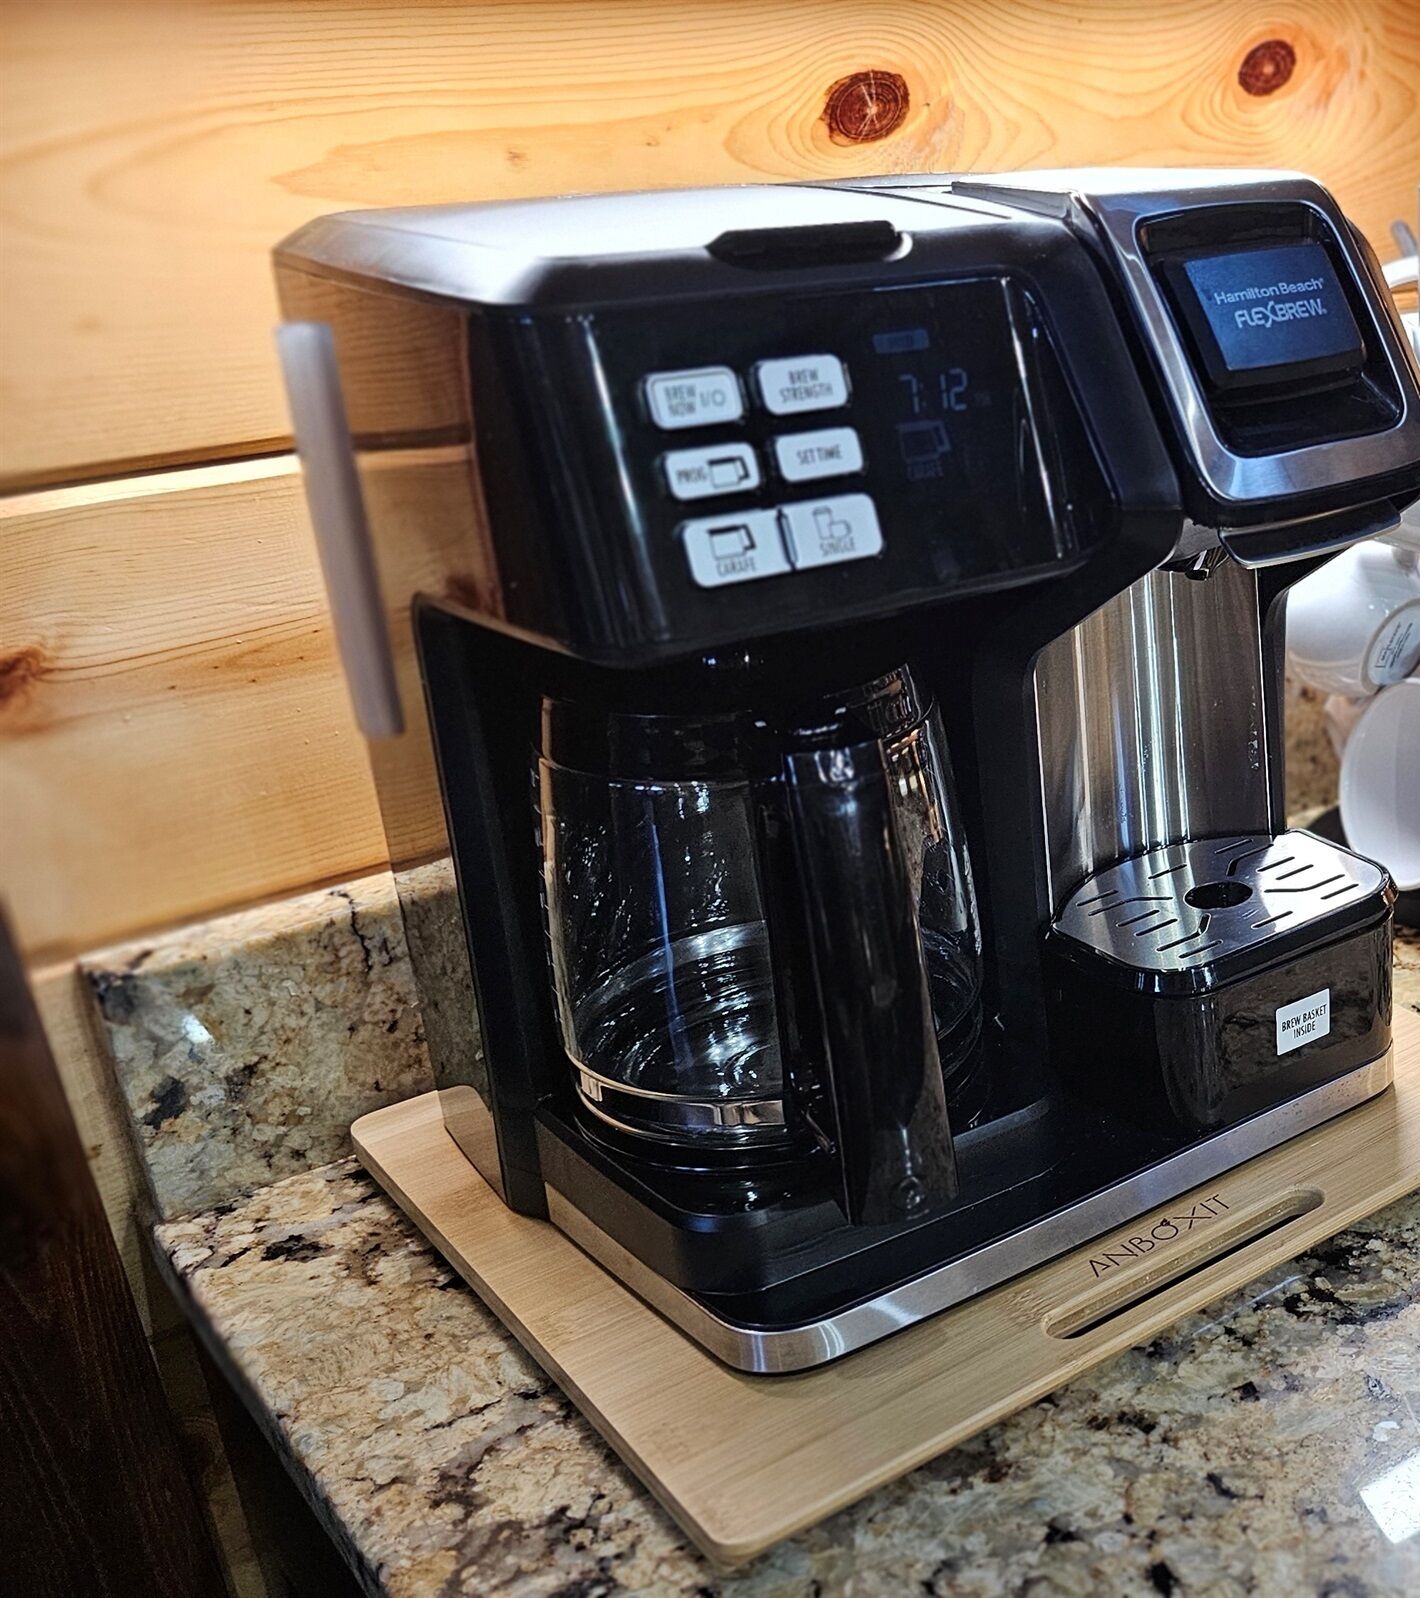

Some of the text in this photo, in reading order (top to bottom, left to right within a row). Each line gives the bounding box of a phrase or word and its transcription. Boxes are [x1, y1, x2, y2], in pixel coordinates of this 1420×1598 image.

[1214, 285, 1280, 304] Hamilton
[787, 367, 819, 385] BREW
[664, 384, 696, 401] BREW
[779, 382, 833, 403] STRENGTH
[898, 368, 969, 414] 7:12
[796, 443, 843, 465] SET TIME
[819, 536, 857, 557] SINGLE
[716, 558, 758, 579] CARAFE
[1281, 1003, 1328, 1033] BREW BASKET
[1293, 1020, 1317, 1040] INSIDE
[1088, 1193, 1230, 1278] ANBOXIT
